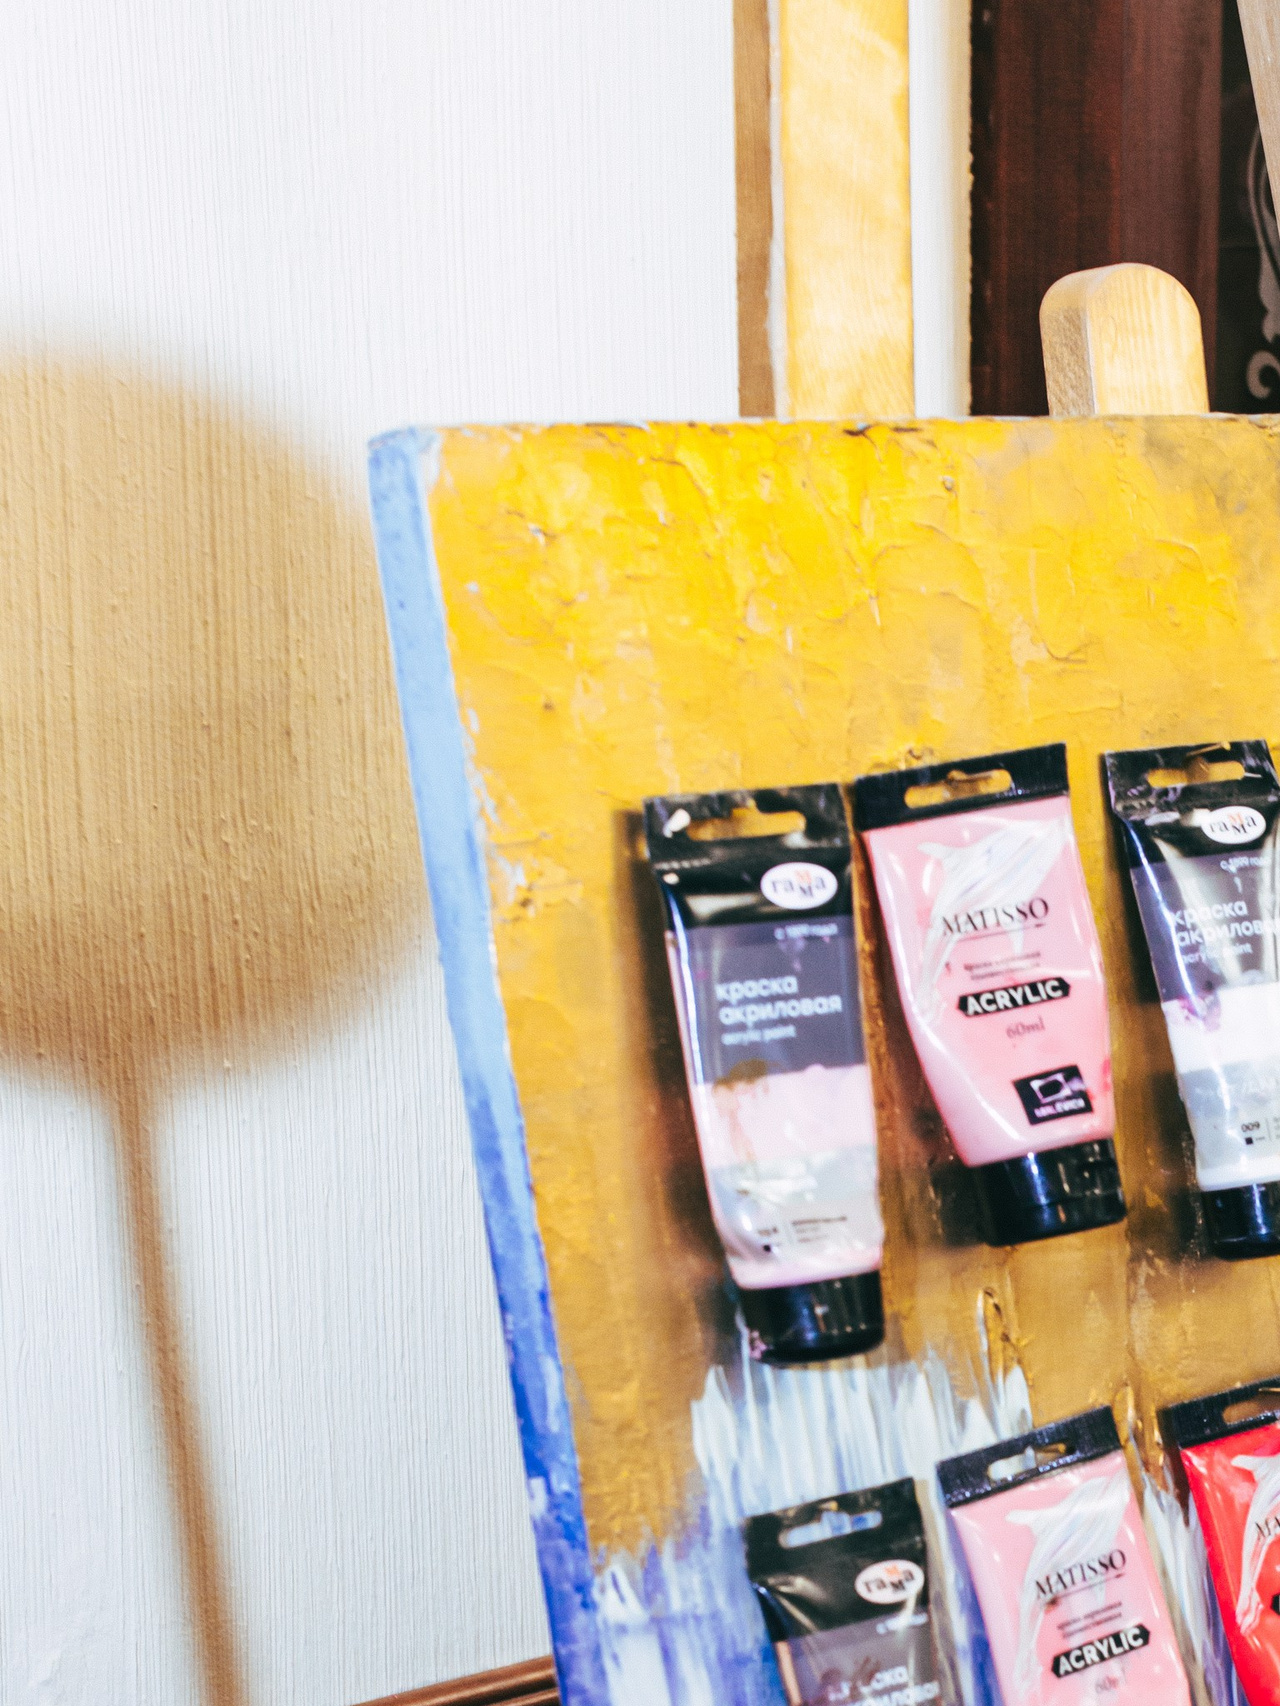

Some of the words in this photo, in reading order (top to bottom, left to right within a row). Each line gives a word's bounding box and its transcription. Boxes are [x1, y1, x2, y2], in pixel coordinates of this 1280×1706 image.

[942, 897, 1049, 937] MATISSO
[714, 976, 799, 1006] краска
[966, 978, 1065, 1016] ACRYLIC
[719, 995, 843, 1029] акриловая
[1034, 1549, 1127, 1599] MATISSO
[1058, 1627, 1145, 1676] ACRYLIC
